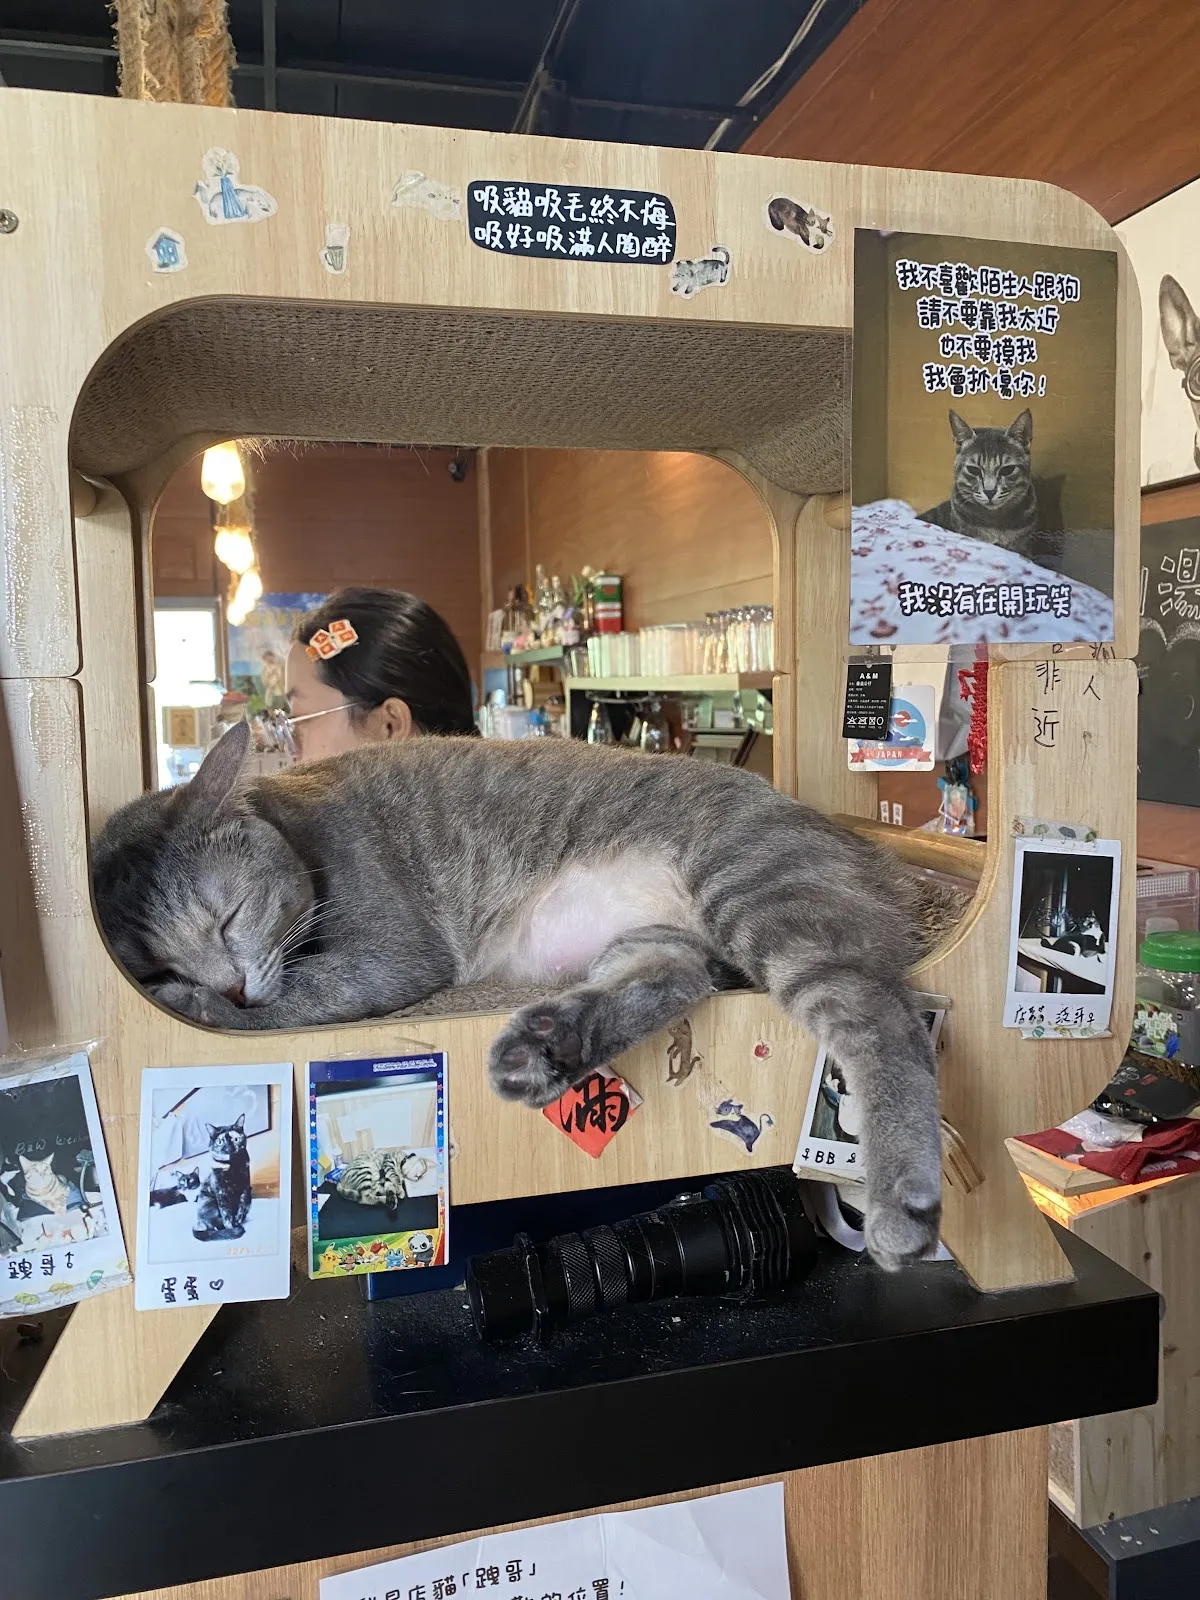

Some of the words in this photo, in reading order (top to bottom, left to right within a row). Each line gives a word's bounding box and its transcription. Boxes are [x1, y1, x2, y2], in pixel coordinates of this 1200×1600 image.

[473, 185, 676, 230] 吸貓吸毛終不悔
[474, 221, 673, 262] 吸好吸滿人陶醉
[897, 259, 1080, 302] 我不喜歡陌生人跟狗
[918, 298, 1059, 333] 請不要靠我太近
[940, 334, 1037, 365] 也不要摸我
[899, 581, 1071, 618] 我沒有在開玩笑
[876, 750, 903, 759] JAPAN
[1133, 1019, 1178, 1033] SOLDIER
[1137, 1010, 1173, 1023] BLACK
[1146, 1029, 1167, 1040] FLY
